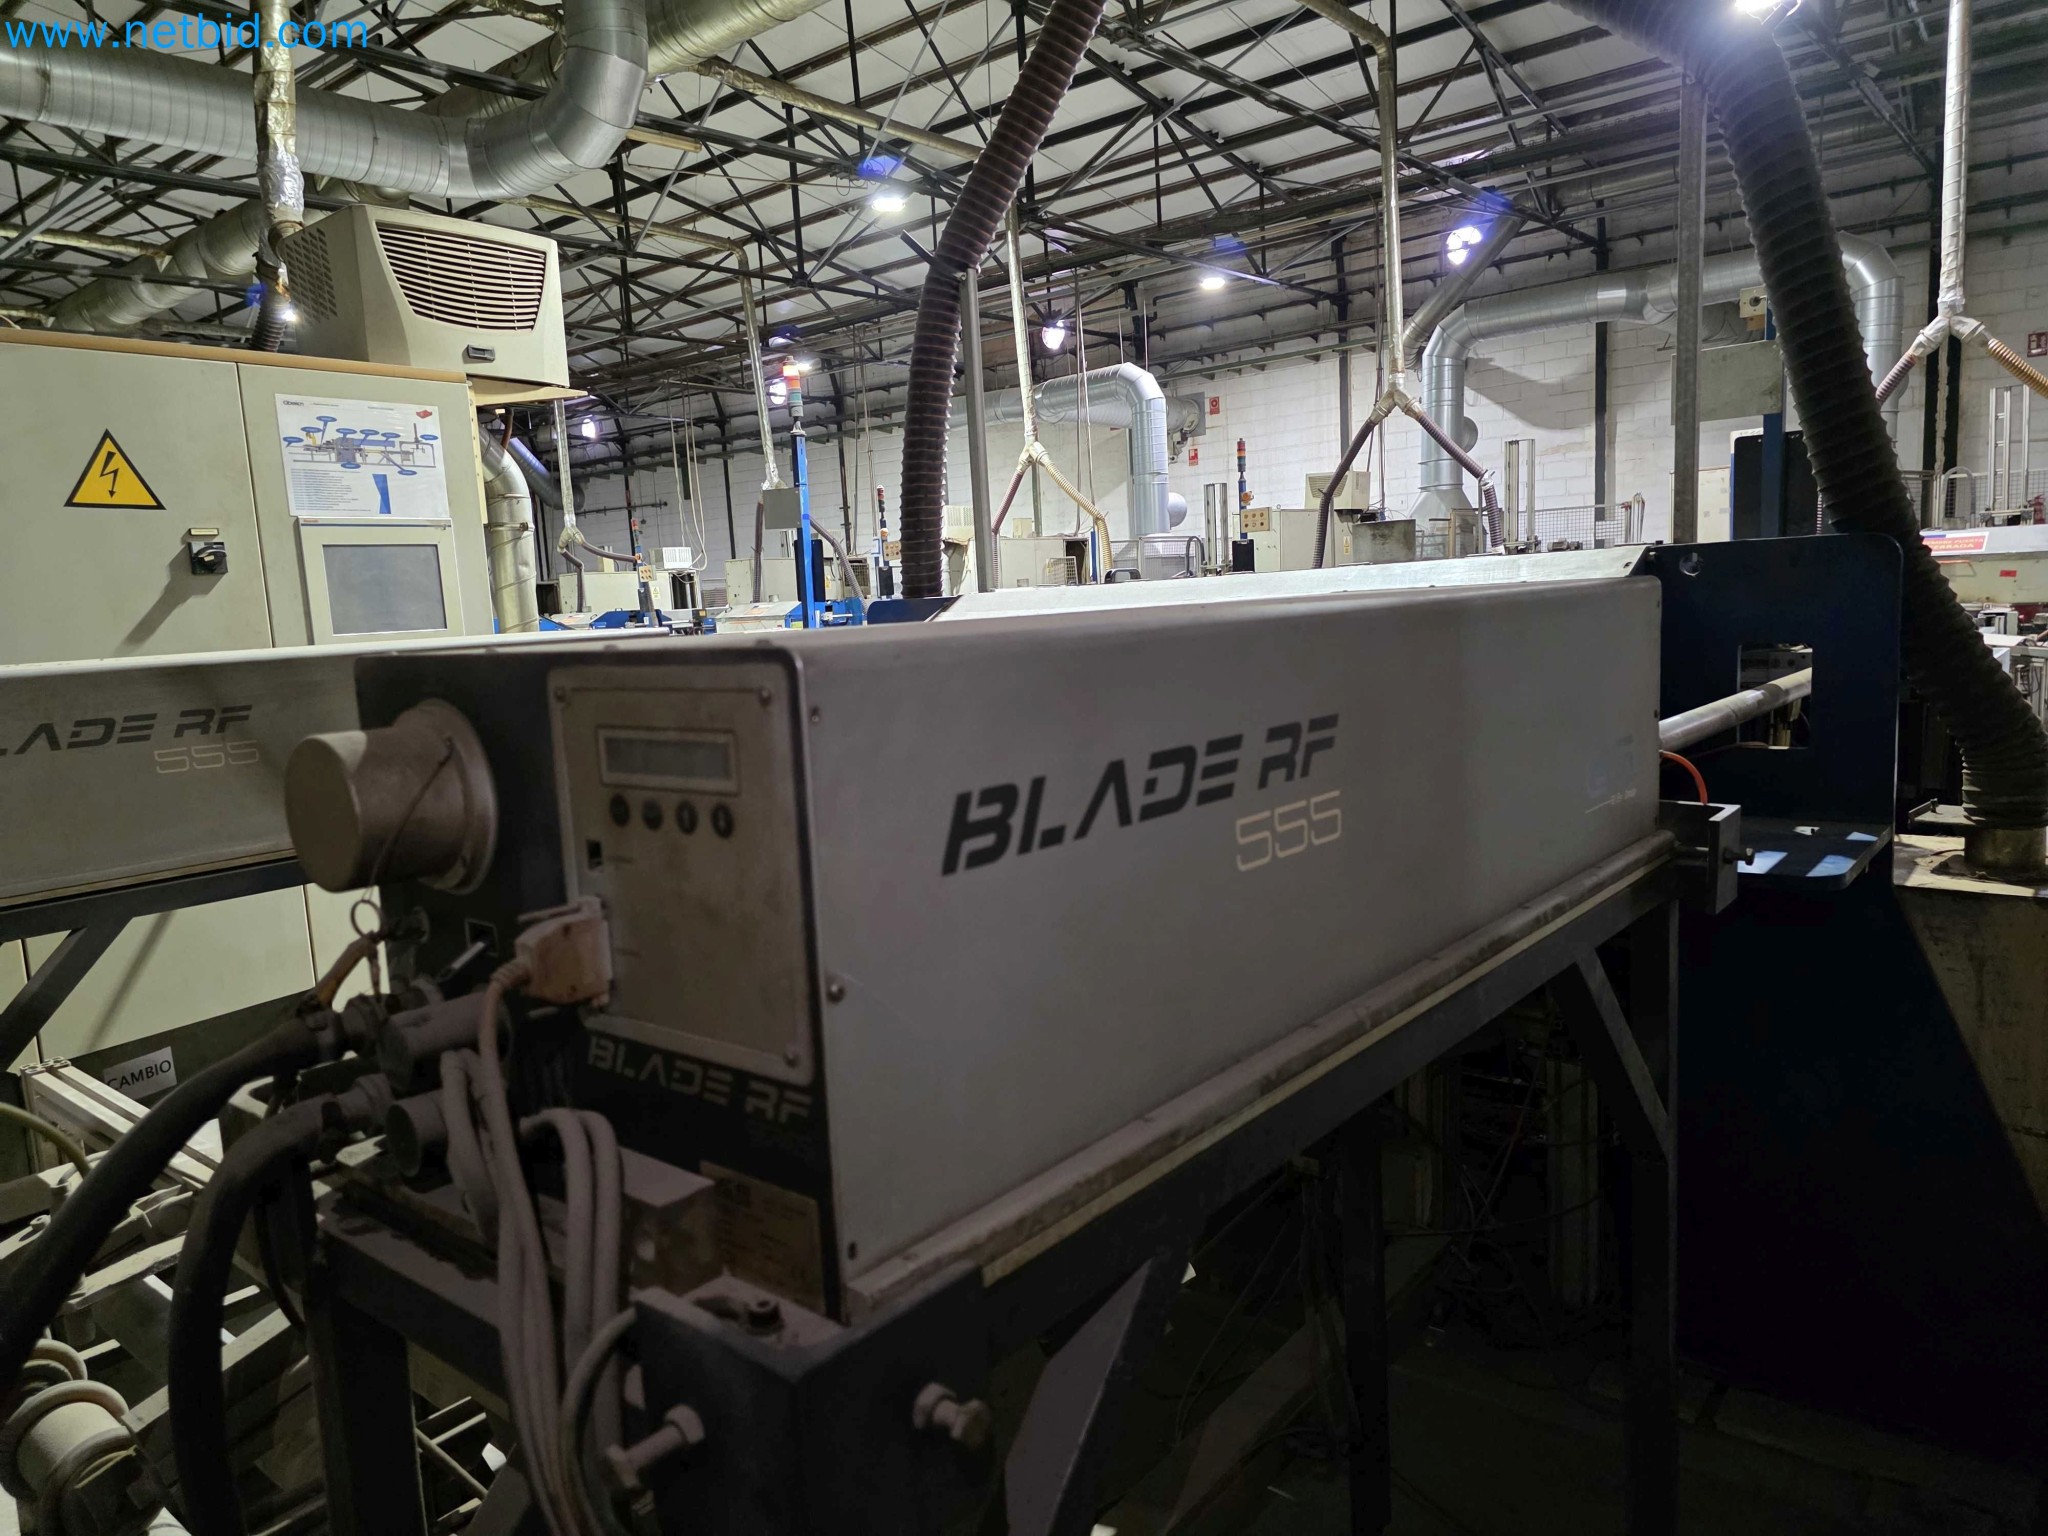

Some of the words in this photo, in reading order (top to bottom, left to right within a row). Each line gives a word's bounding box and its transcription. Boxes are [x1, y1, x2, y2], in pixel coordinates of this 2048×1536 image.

[0, 713, 158, 757] ADE
[173, 704, 253, 738] RF
[941, 733, 1244, 876] BLADE
[1257, 713, 1339, 790] RF
[1236, 790, 1342, 872] 555
[107, 1060, 172, 1091] CAMBIO
[587, 1035, 734, 1107] BLADE
[746, 1080, 813, 1123] RF
